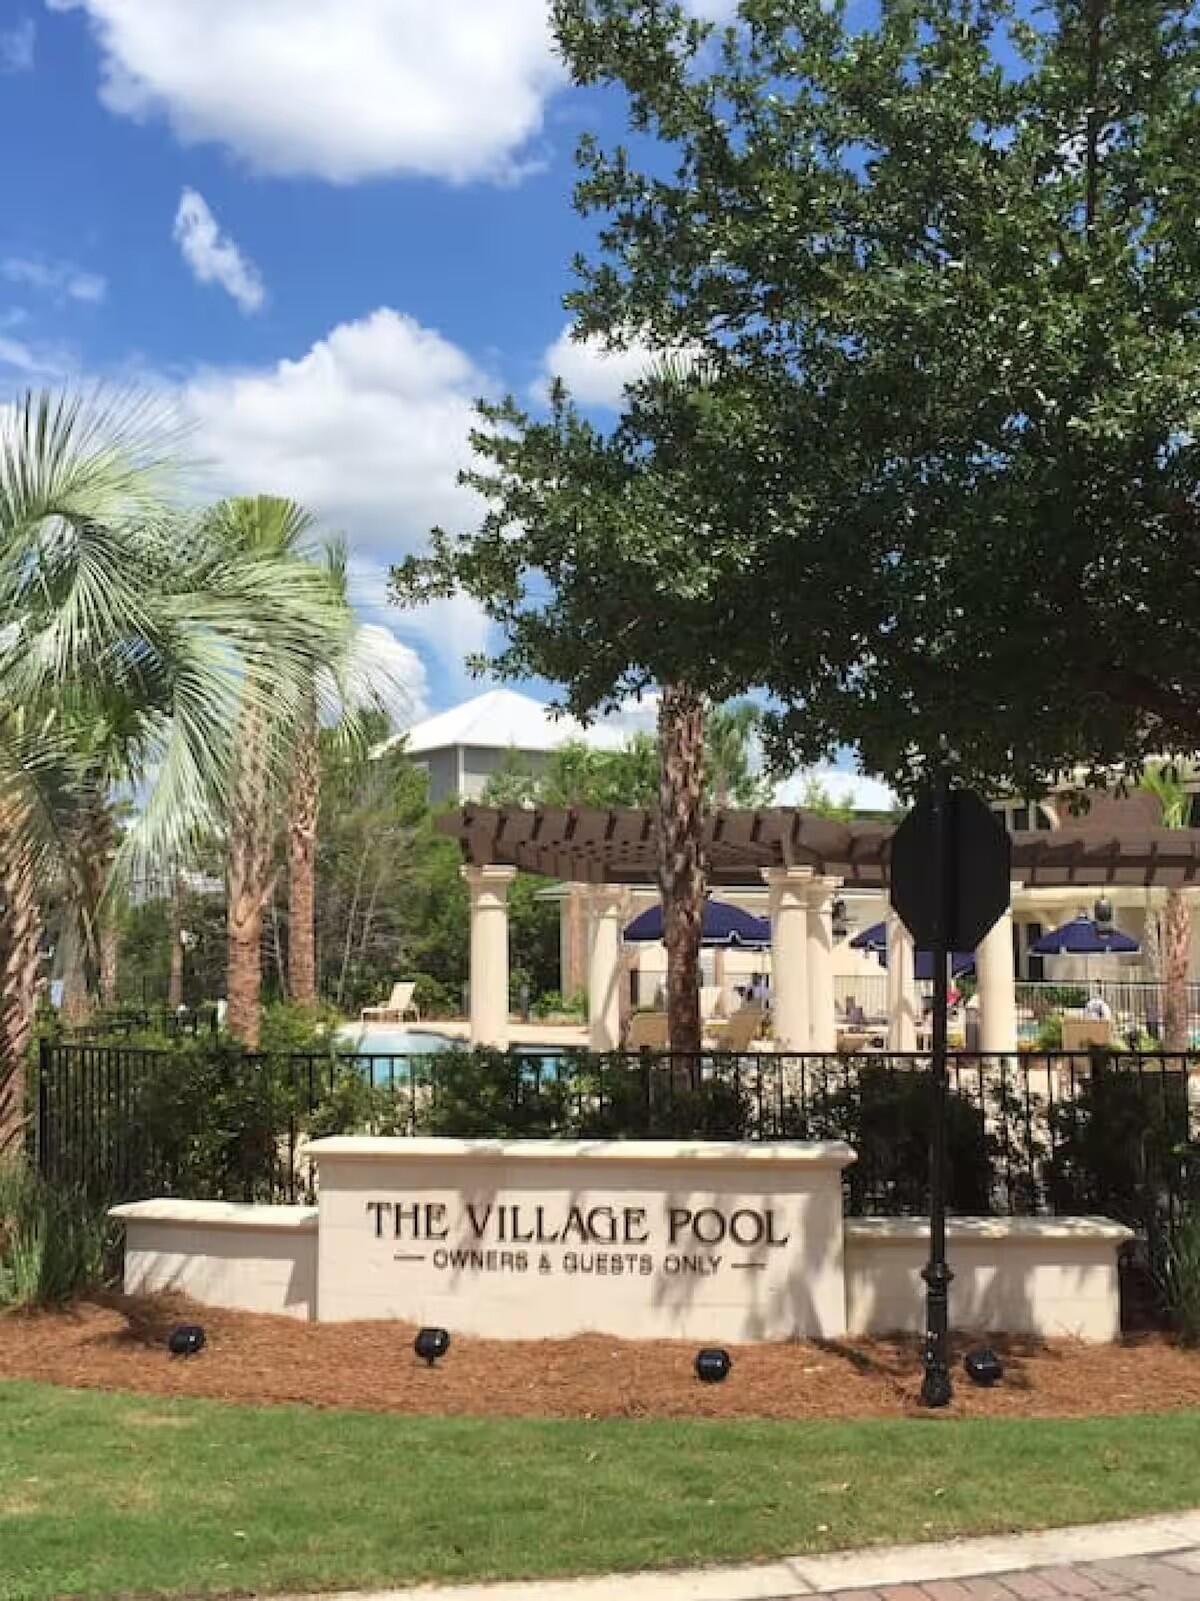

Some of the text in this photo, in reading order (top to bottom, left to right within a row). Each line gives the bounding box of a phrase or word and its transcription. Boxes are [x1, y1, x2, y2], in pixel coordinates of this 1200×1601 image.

[366, 1201, 790, 1247] THE VILLAGE POOL
[433, 1248, 722, 1275] OWNERS & GUESTS ONLY
